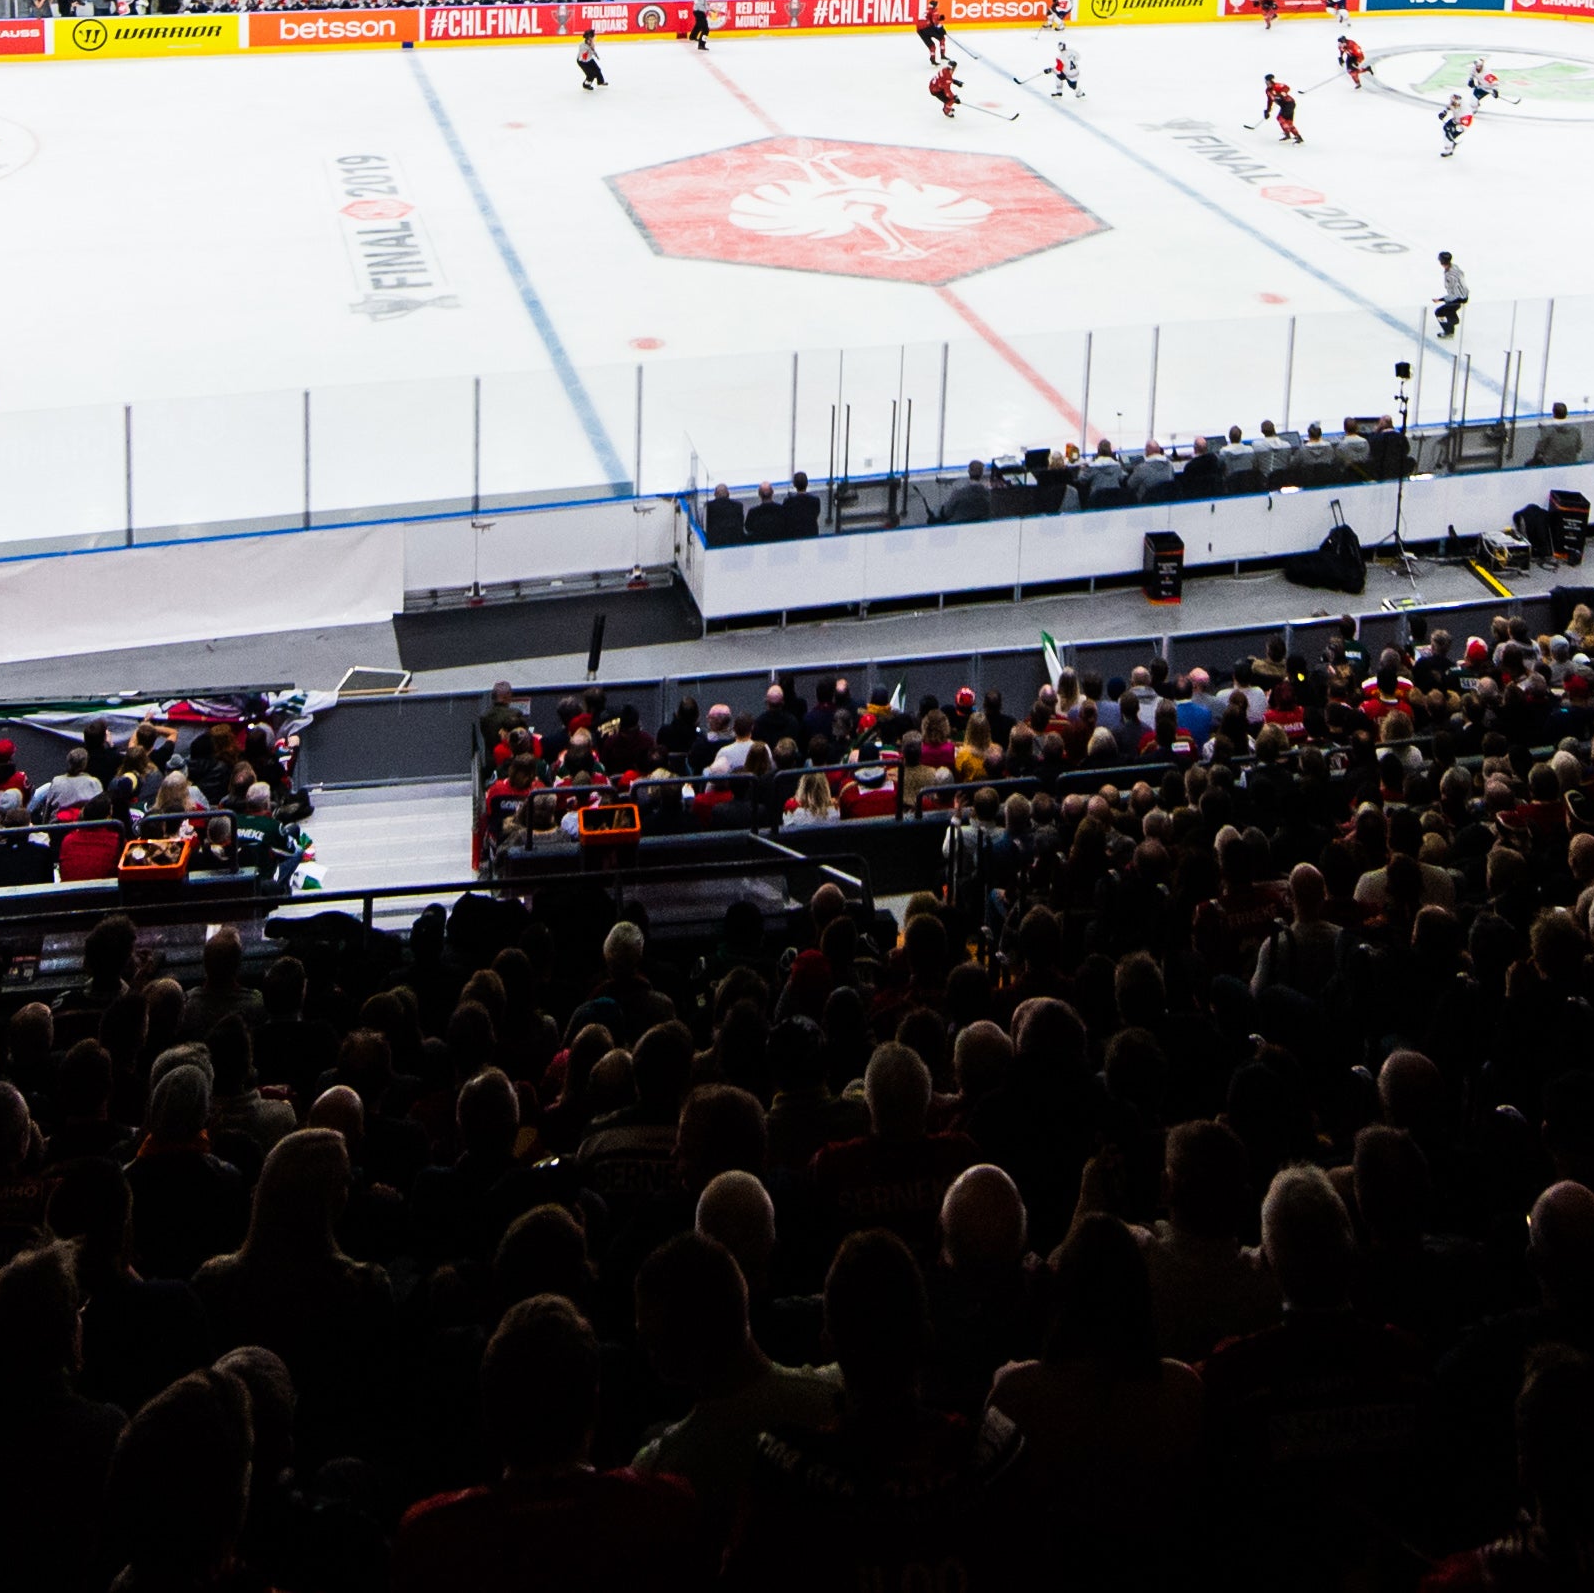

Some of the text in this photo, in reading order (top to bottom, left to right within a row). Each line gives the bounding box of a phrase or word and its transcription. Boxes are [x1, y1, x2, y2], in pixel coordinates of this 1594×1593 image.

[678, 9, 689, 19] VS
[735, 1, 777, 15] RED BULL
[950, 0, 1047, 19] betsson
[279, 18, 396, 40] betsson
[430, 7, 543, 37] #CHLFINAL
[591, 18, 628, 32] INDIANS
[735, 13, 770, 28] MUNICH
[114, 25, 222, 40] WARRIOR
[1173, 135, 1410, 255] FINAL 2019
[336, 155, 433, 290] FINAL 2019
